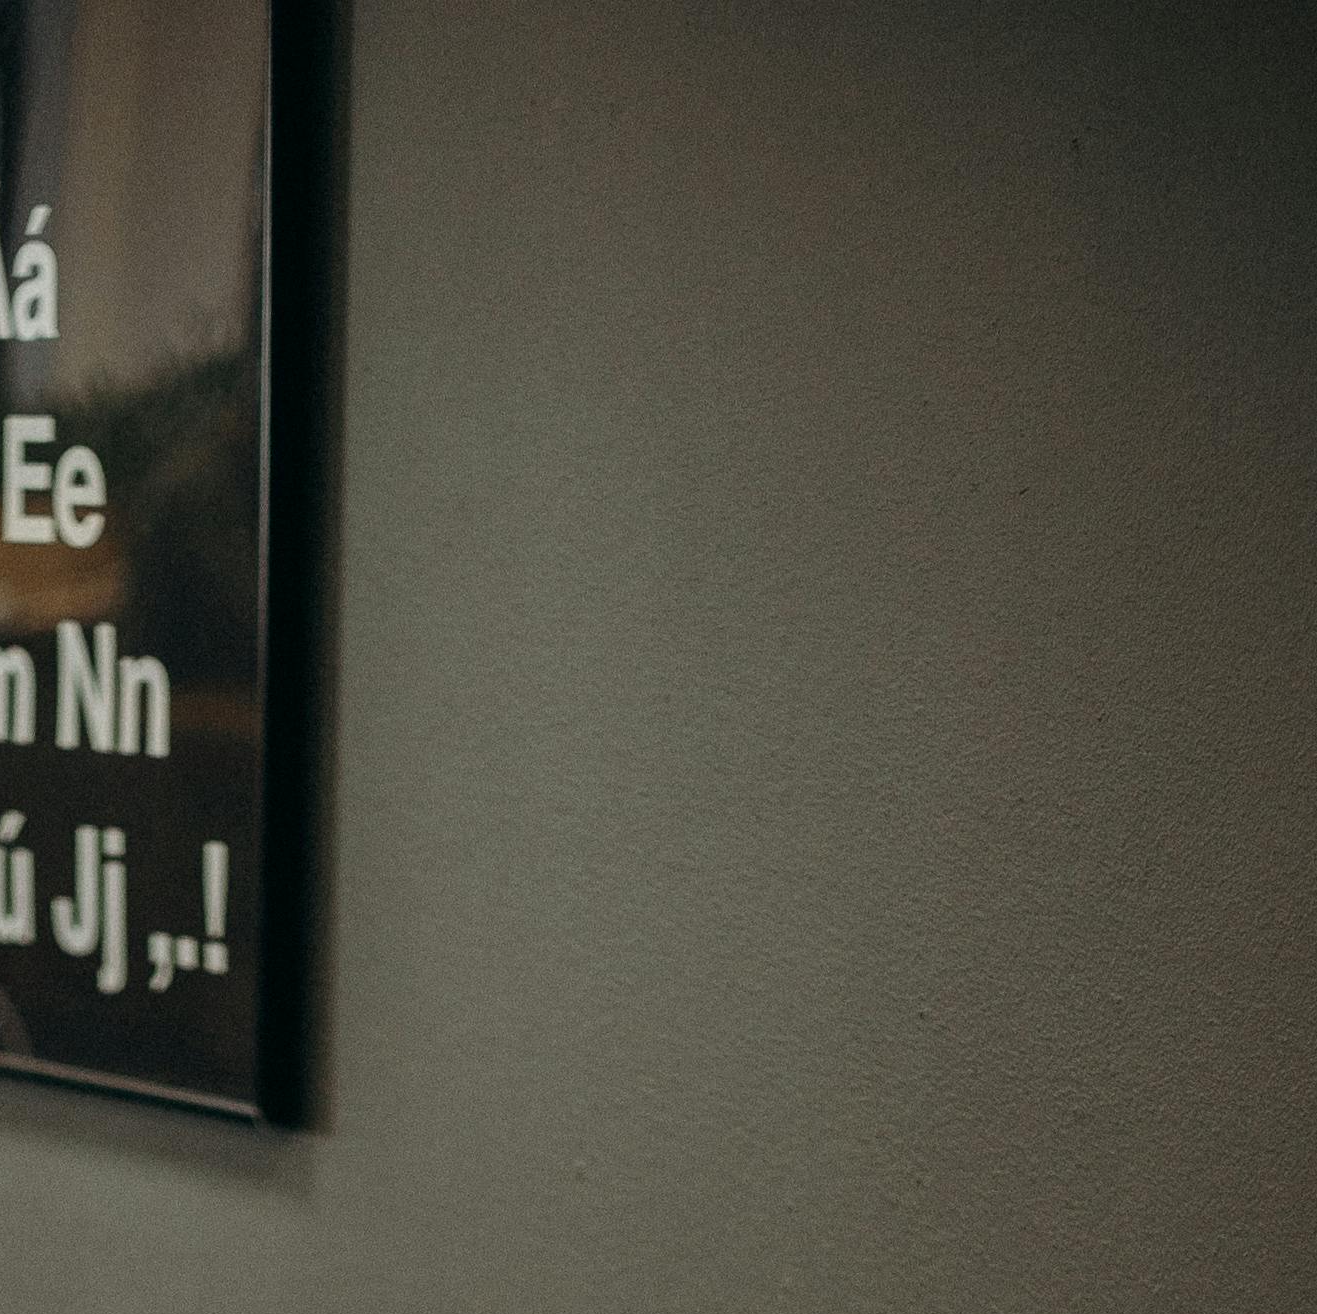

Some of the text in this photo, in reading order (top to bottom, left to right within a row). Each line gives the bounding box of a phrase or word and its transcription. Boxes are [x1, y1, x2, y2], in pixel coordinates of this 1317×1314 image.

[2, 414, 106, 549] Ee
[56, 620, 169, 758] Nn
[51, 824, 127, 994] Jj
